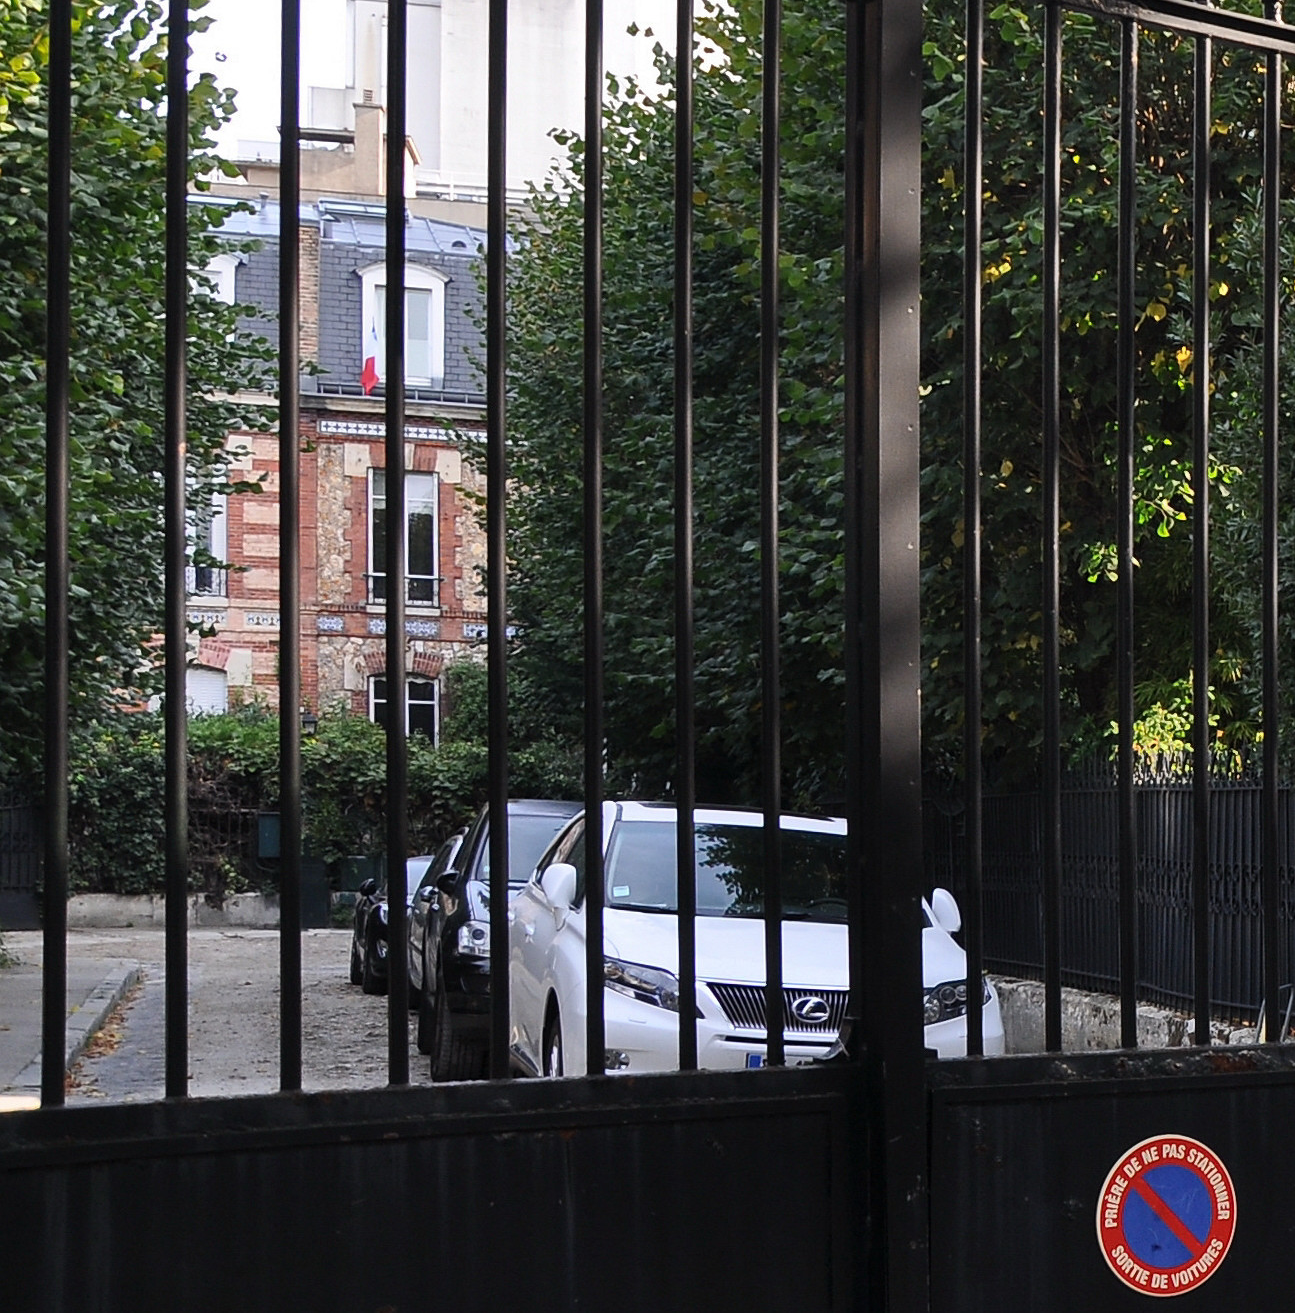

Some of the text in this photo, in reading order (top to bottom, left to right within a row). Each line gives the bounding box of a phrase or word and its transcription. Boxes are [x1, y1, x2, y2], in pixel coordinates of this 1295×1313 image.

[1104, 1144, 1230, 1228] PRIÈRE DE NE PAS STATIONNER
[1111, 1238, 1224, 1289] SORTIE DE VOITURES
